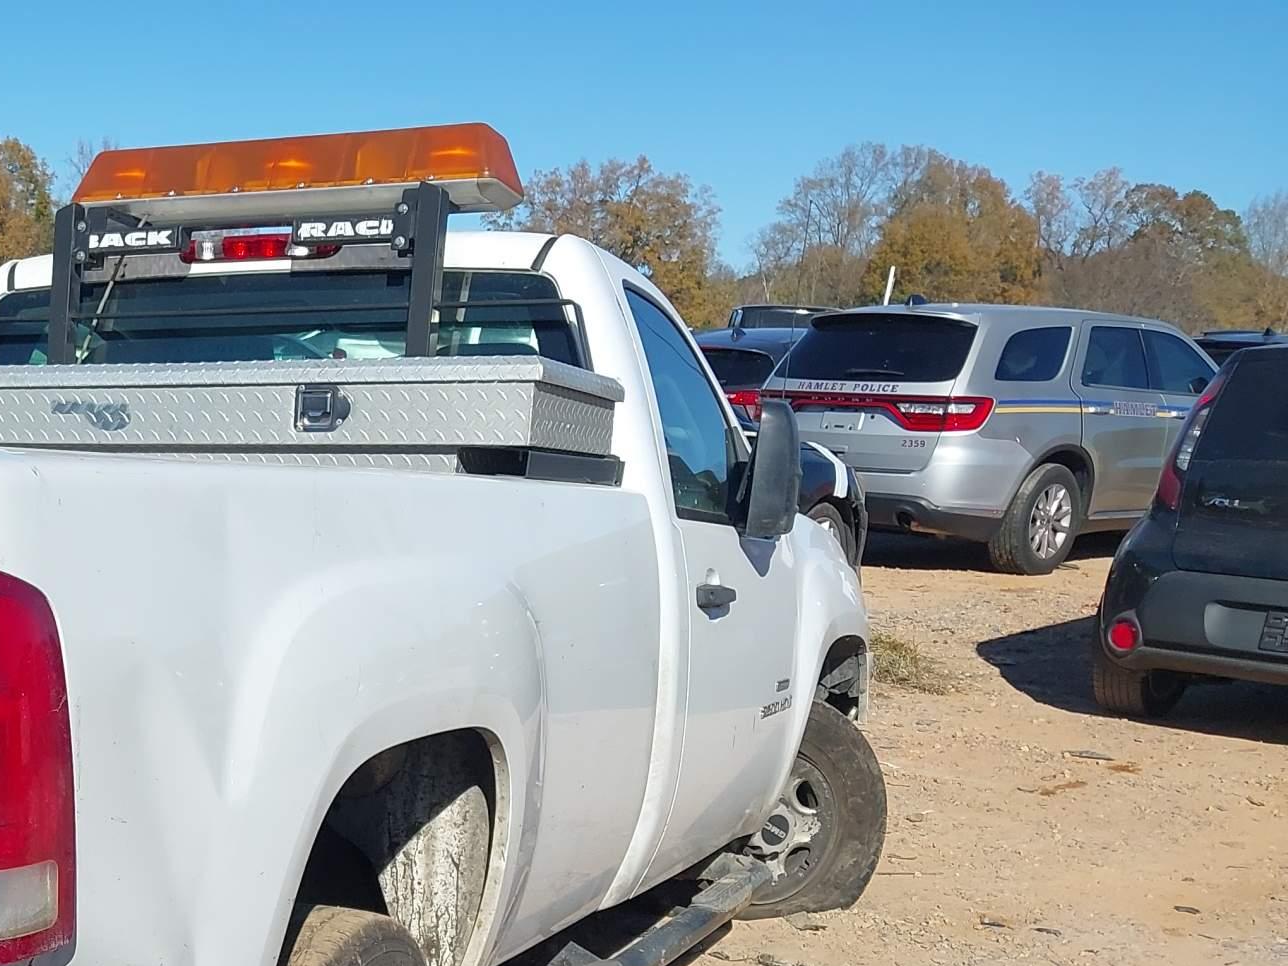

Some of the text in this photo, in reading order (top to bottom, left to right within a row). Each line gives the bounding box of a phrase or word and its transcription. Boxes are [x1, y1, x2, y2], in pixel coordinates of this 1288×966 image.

[797, 381, 900, 393] HAMLET POLICE
[901, 439, 926, 448] 2359
